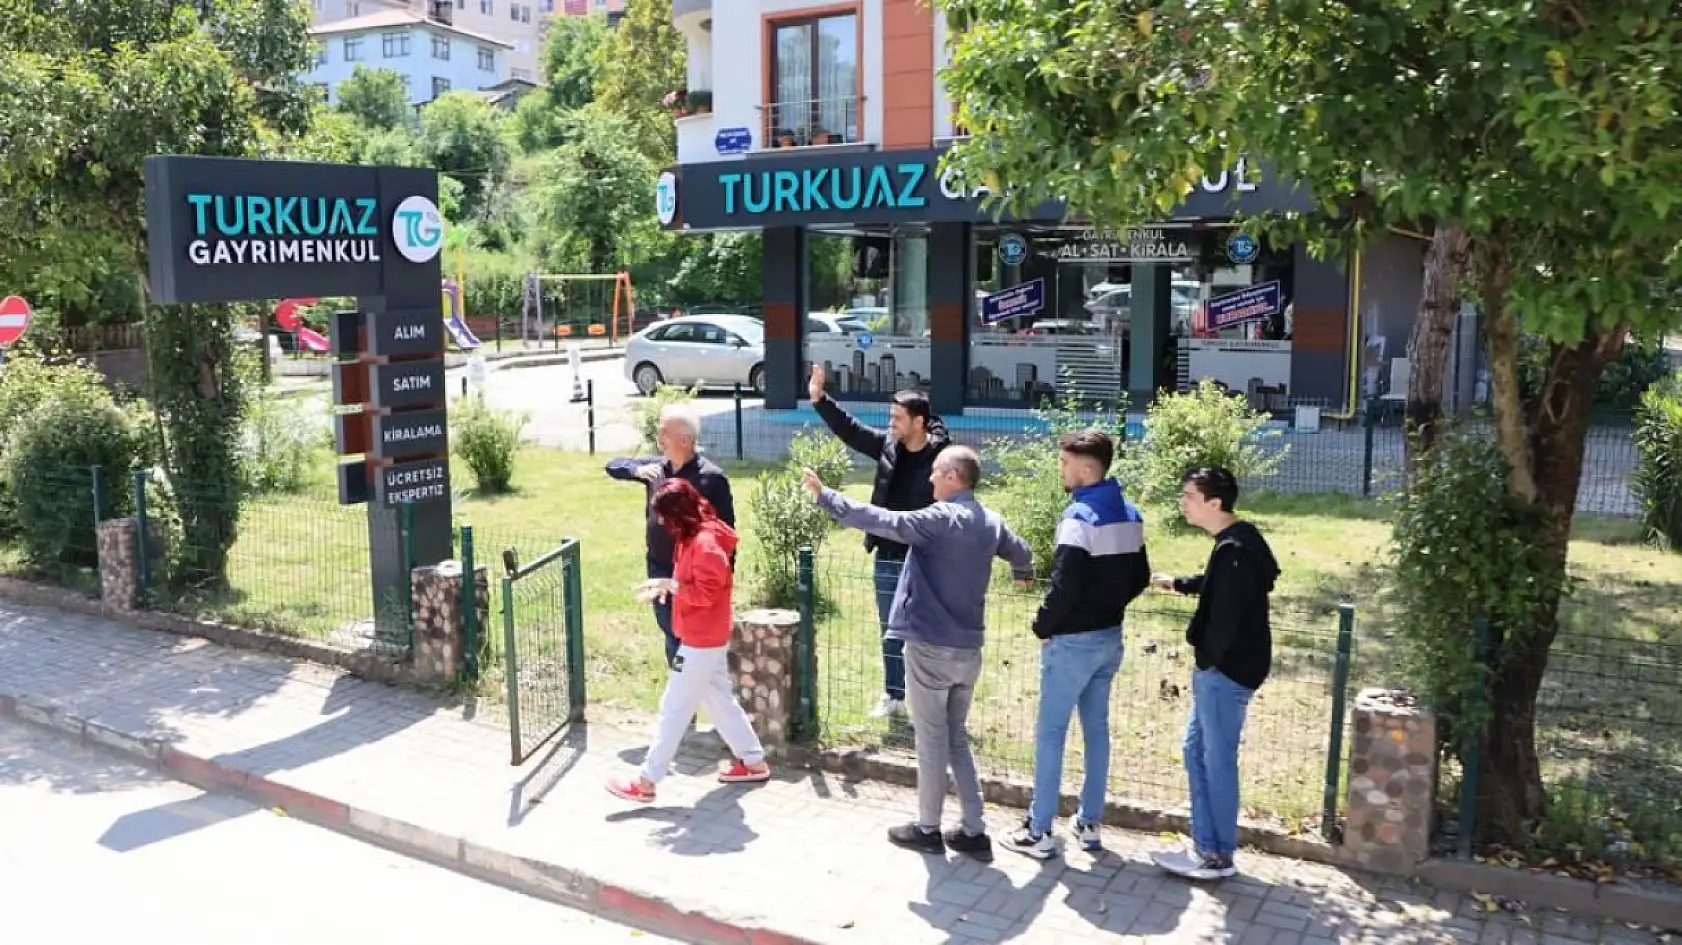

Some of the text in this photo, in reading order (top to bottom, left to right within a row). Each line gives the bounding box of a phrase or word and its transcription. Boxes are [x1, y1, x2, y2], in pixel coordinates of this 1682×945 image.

[719, 163, 924, 213] TURKUAZ
[188, 194, 377, 235] TURKUAZ
[397, 210, 440, 247] TG
[1061, 243, 1080, 257] AL
[1090, 243, 1119, 257] SAT
[394, 325, 425, 340] ALIM
[393, 375, 431, 391] SATIM
[384, 425, 442, 442] KİRALAMA
